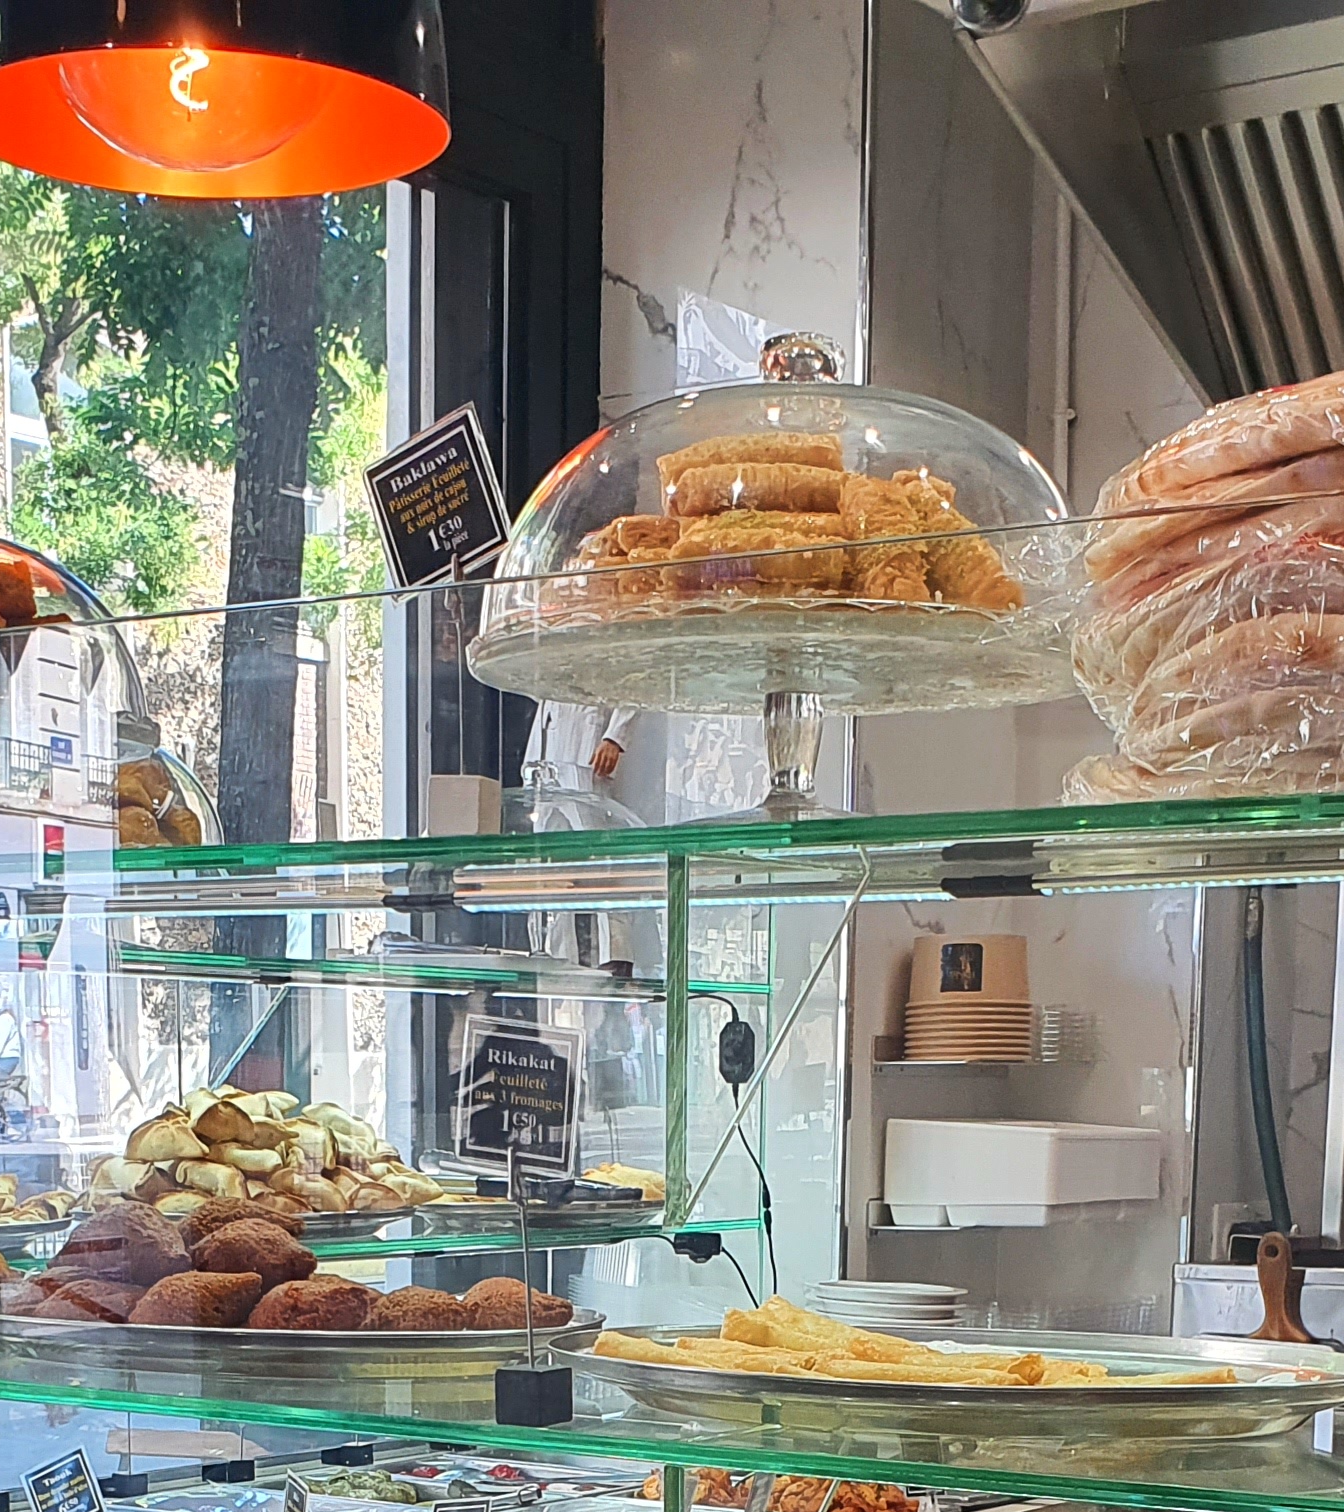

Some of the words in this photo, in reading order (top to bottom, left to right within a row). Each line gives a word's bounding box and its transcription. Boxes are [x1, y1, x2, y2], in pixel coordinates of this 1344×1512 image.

[389, 447, 458, 493] Baklawa
[434, 490, 444, 502] de
[437, 504, 447, 516] de
[428, 515, 463, 552] 1€30
[488, 1048, 555, 1071] Rikakat
[492, 1070, 548, 1090] Feuilleté
[511, 1091, 564, 1112] fromages
[501, 1109, 537, 1132] 1€50
